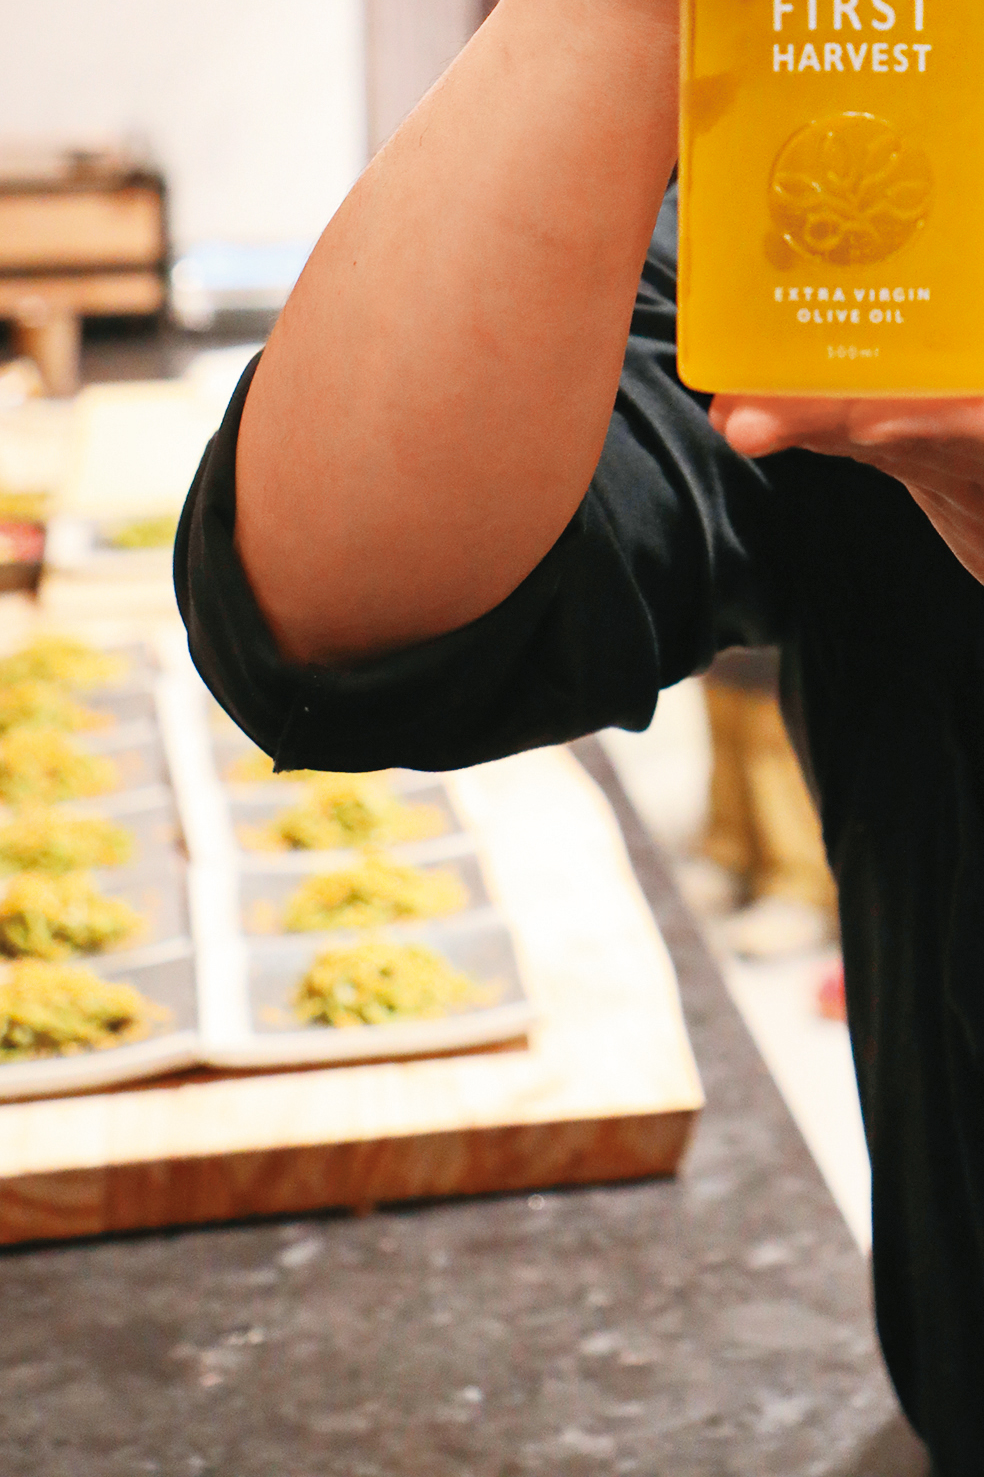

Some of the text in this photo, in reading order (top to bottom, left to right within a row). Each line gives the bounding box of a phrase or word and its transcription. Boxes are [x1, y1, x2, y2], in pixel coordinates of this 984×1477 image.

[773, 42, 932, 72] HARVEST
[774, 286, 931, 302] EXTRA VIRGIN
[796, 308, 904, 324] OLIVE OIL
